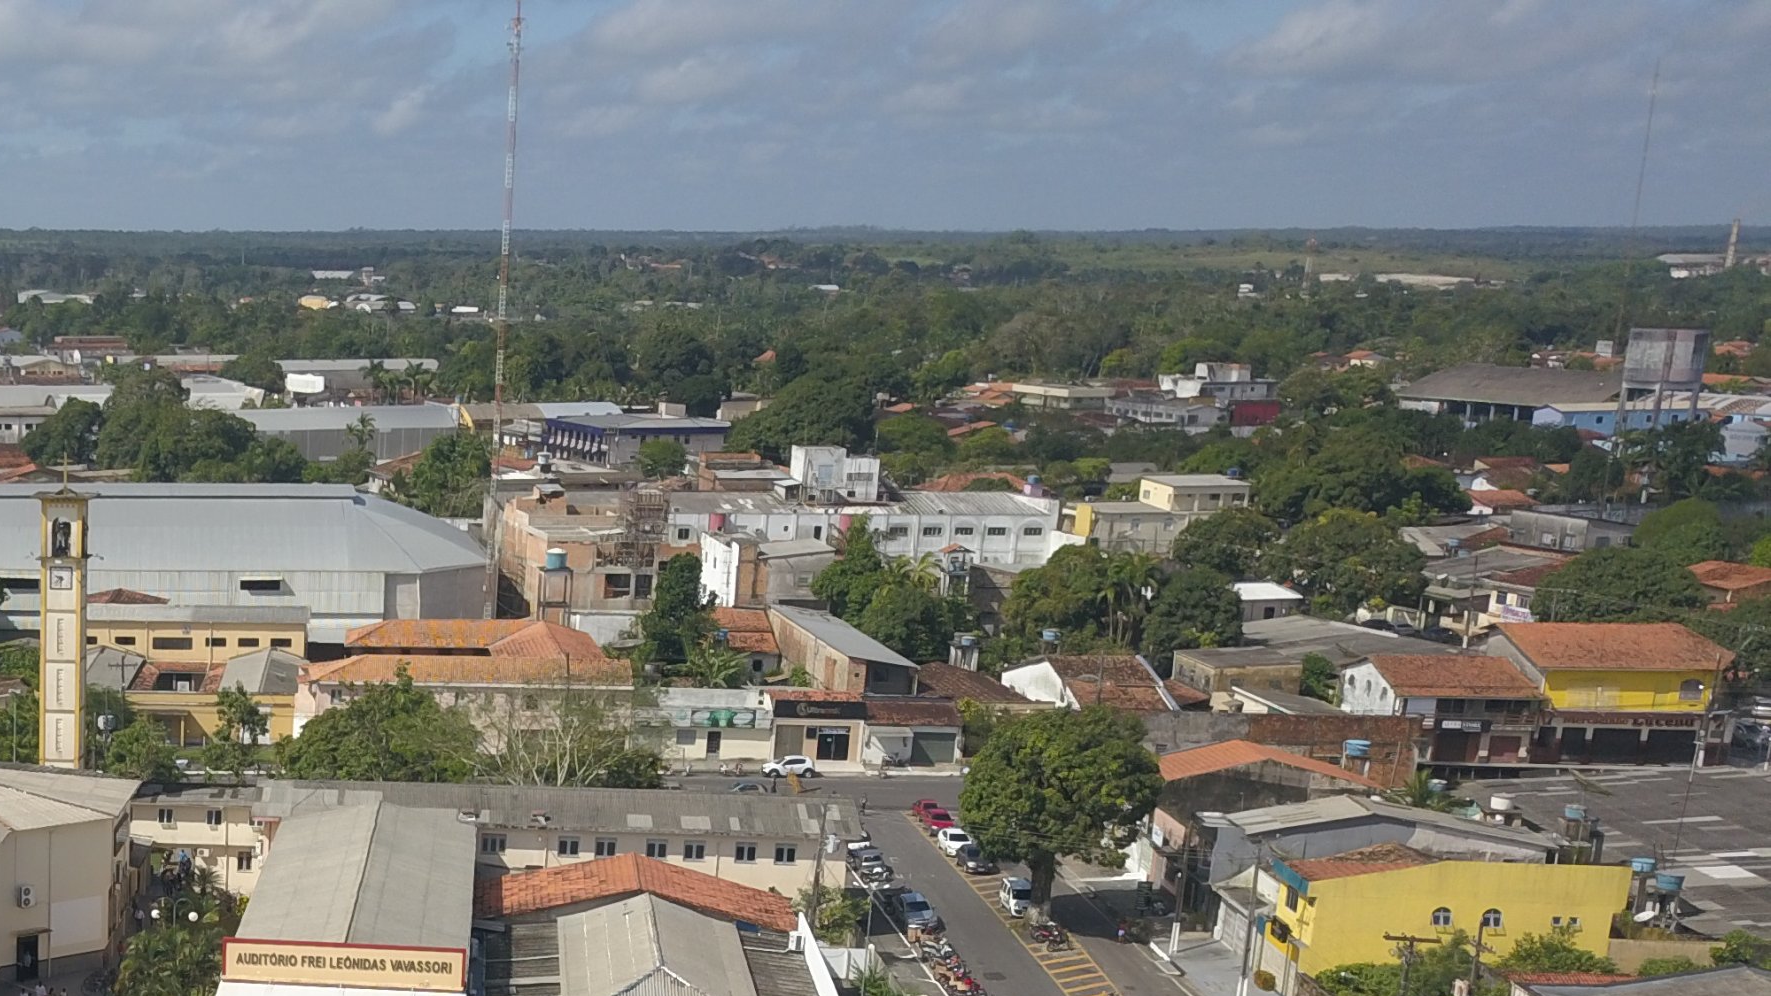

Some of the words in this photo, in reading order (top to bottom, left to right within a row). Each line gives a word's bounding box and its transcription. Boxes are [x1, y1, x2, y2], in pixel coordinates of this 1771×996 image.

[236, 953, 297, 966] AUDITÓRIO
[301, 955, 326, 968] FREI
[330, 956, 386, 970] LEÔNIDAS
[391, 960, 452, 974] VAVASSORI
